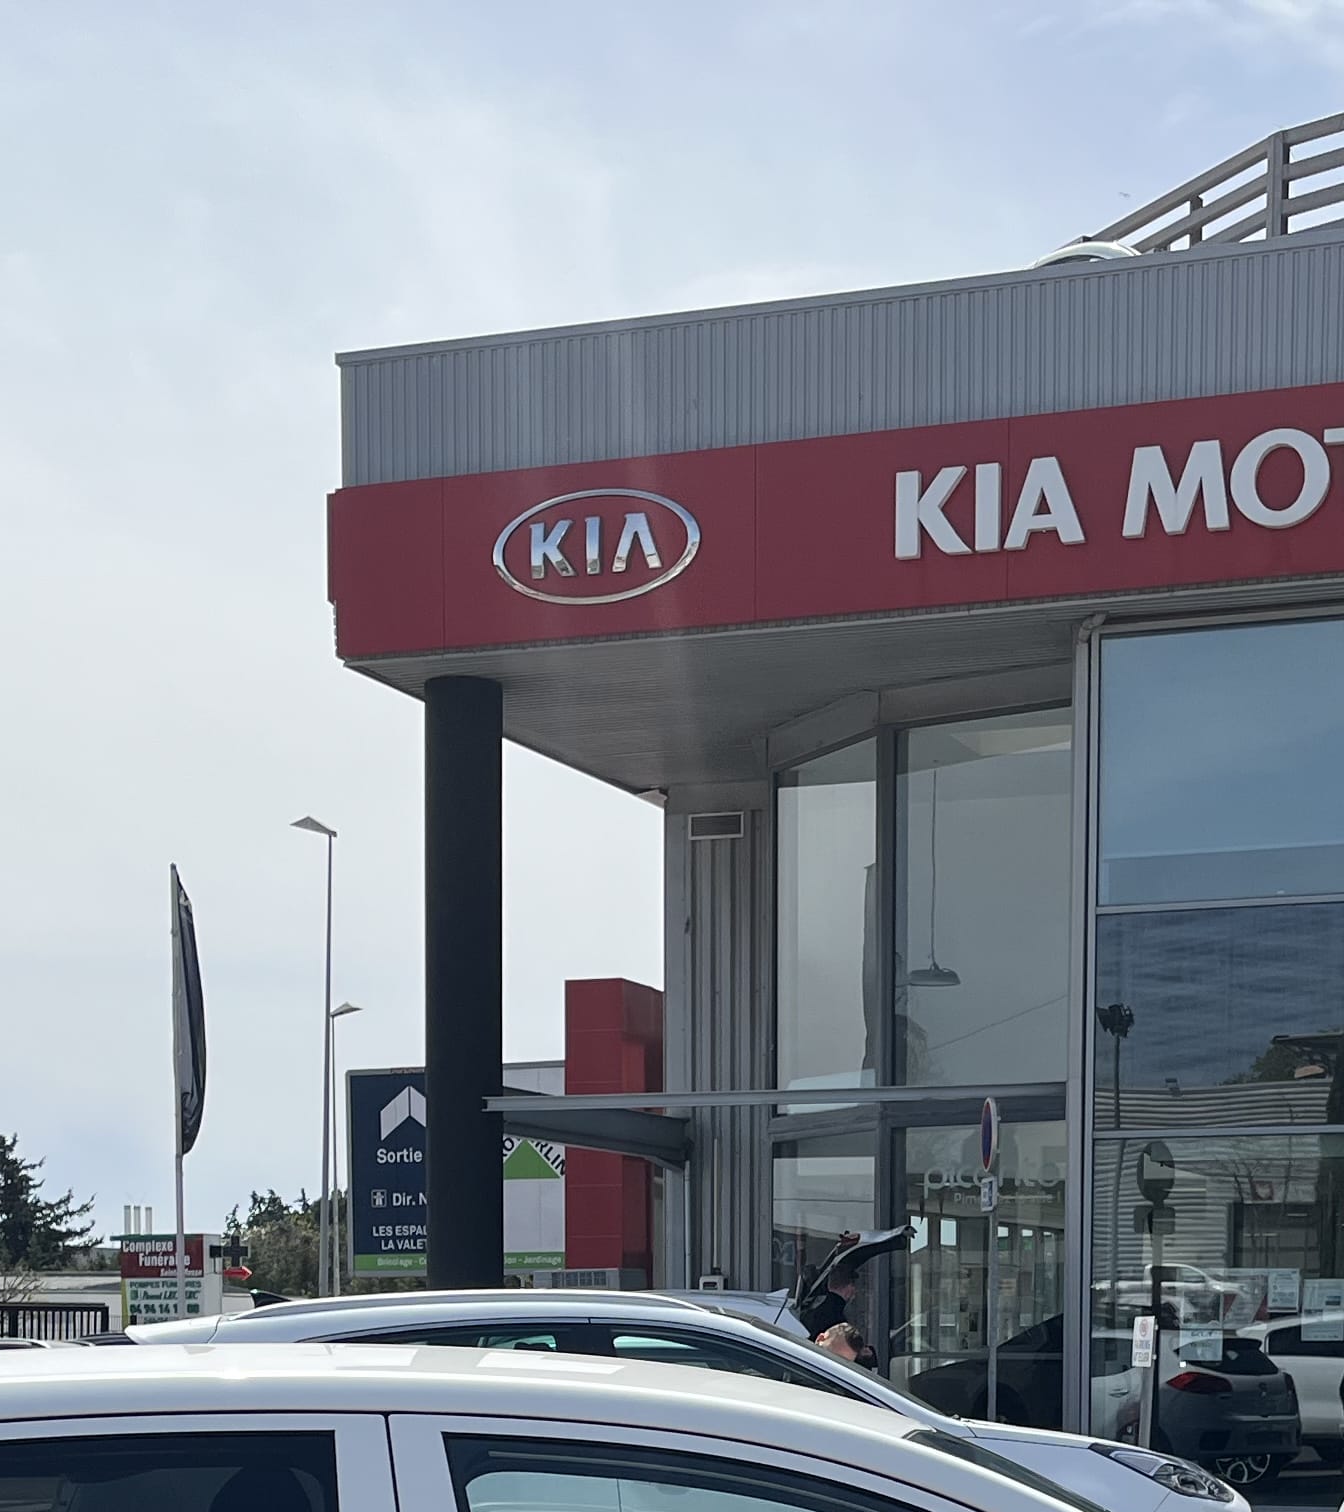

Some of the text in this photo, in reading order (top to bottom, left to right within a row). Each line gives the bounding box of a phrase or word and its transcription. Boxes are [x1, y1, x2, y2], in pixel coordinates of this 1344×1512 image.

[895, 456, 1085, 560] KIA
[529, 512, 663, 580] KIA
[376, 1147, 423, 1164] Sortie
[392, 1192, 416, 1207] Dir.
[372, 1224, 428, 1237] LES ESPAL
[122, 1239, 174, 1255] Complexe
[381, 1239, 428, 1250] LA VALET
[138, 1251, 191, 1267] Funérae
